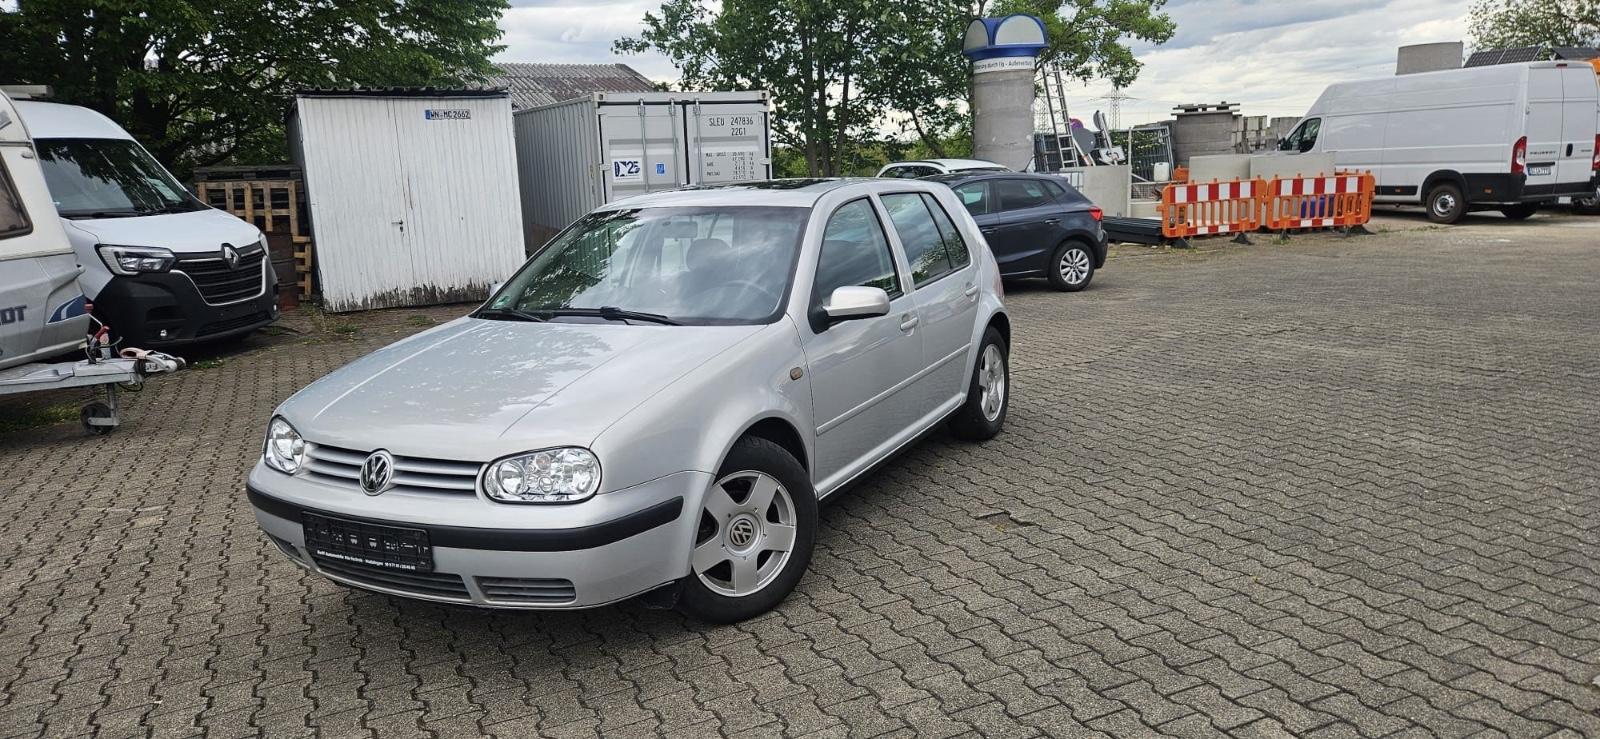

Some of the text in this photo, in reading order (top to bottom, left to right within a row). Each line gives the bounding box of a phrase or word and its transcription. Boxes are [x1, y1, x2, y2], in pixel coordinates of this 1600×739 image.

[708, 117, 725, 126] SLEU
[730, 116, 754, 126] 247836
[0, 305, 27, 326] DT
